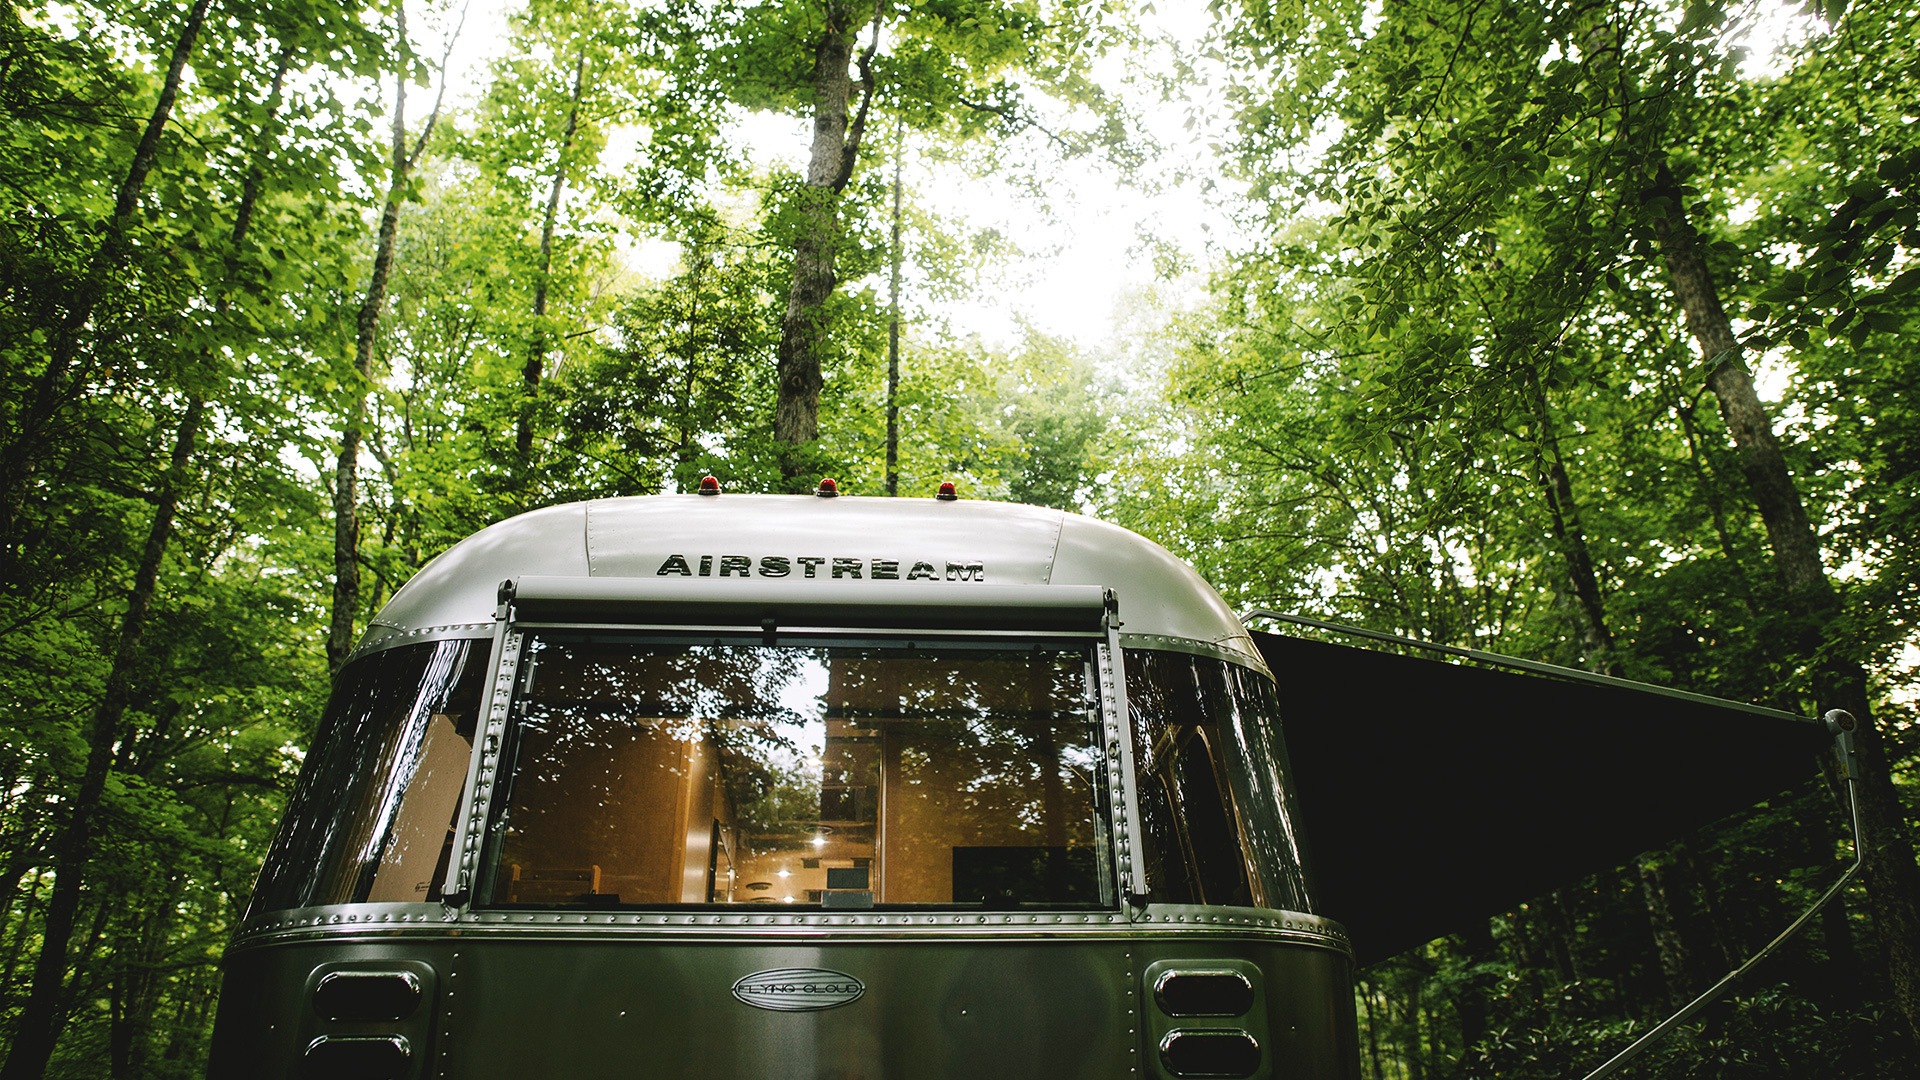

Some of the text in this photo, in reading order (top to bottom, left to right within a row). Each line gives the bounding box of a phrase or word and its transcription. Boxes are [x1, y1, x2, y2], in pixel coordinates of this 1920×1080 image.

[656, 554, 984, 581] AIRSTREAM
[737, 983, 859, 994] FLYING CLOUD
